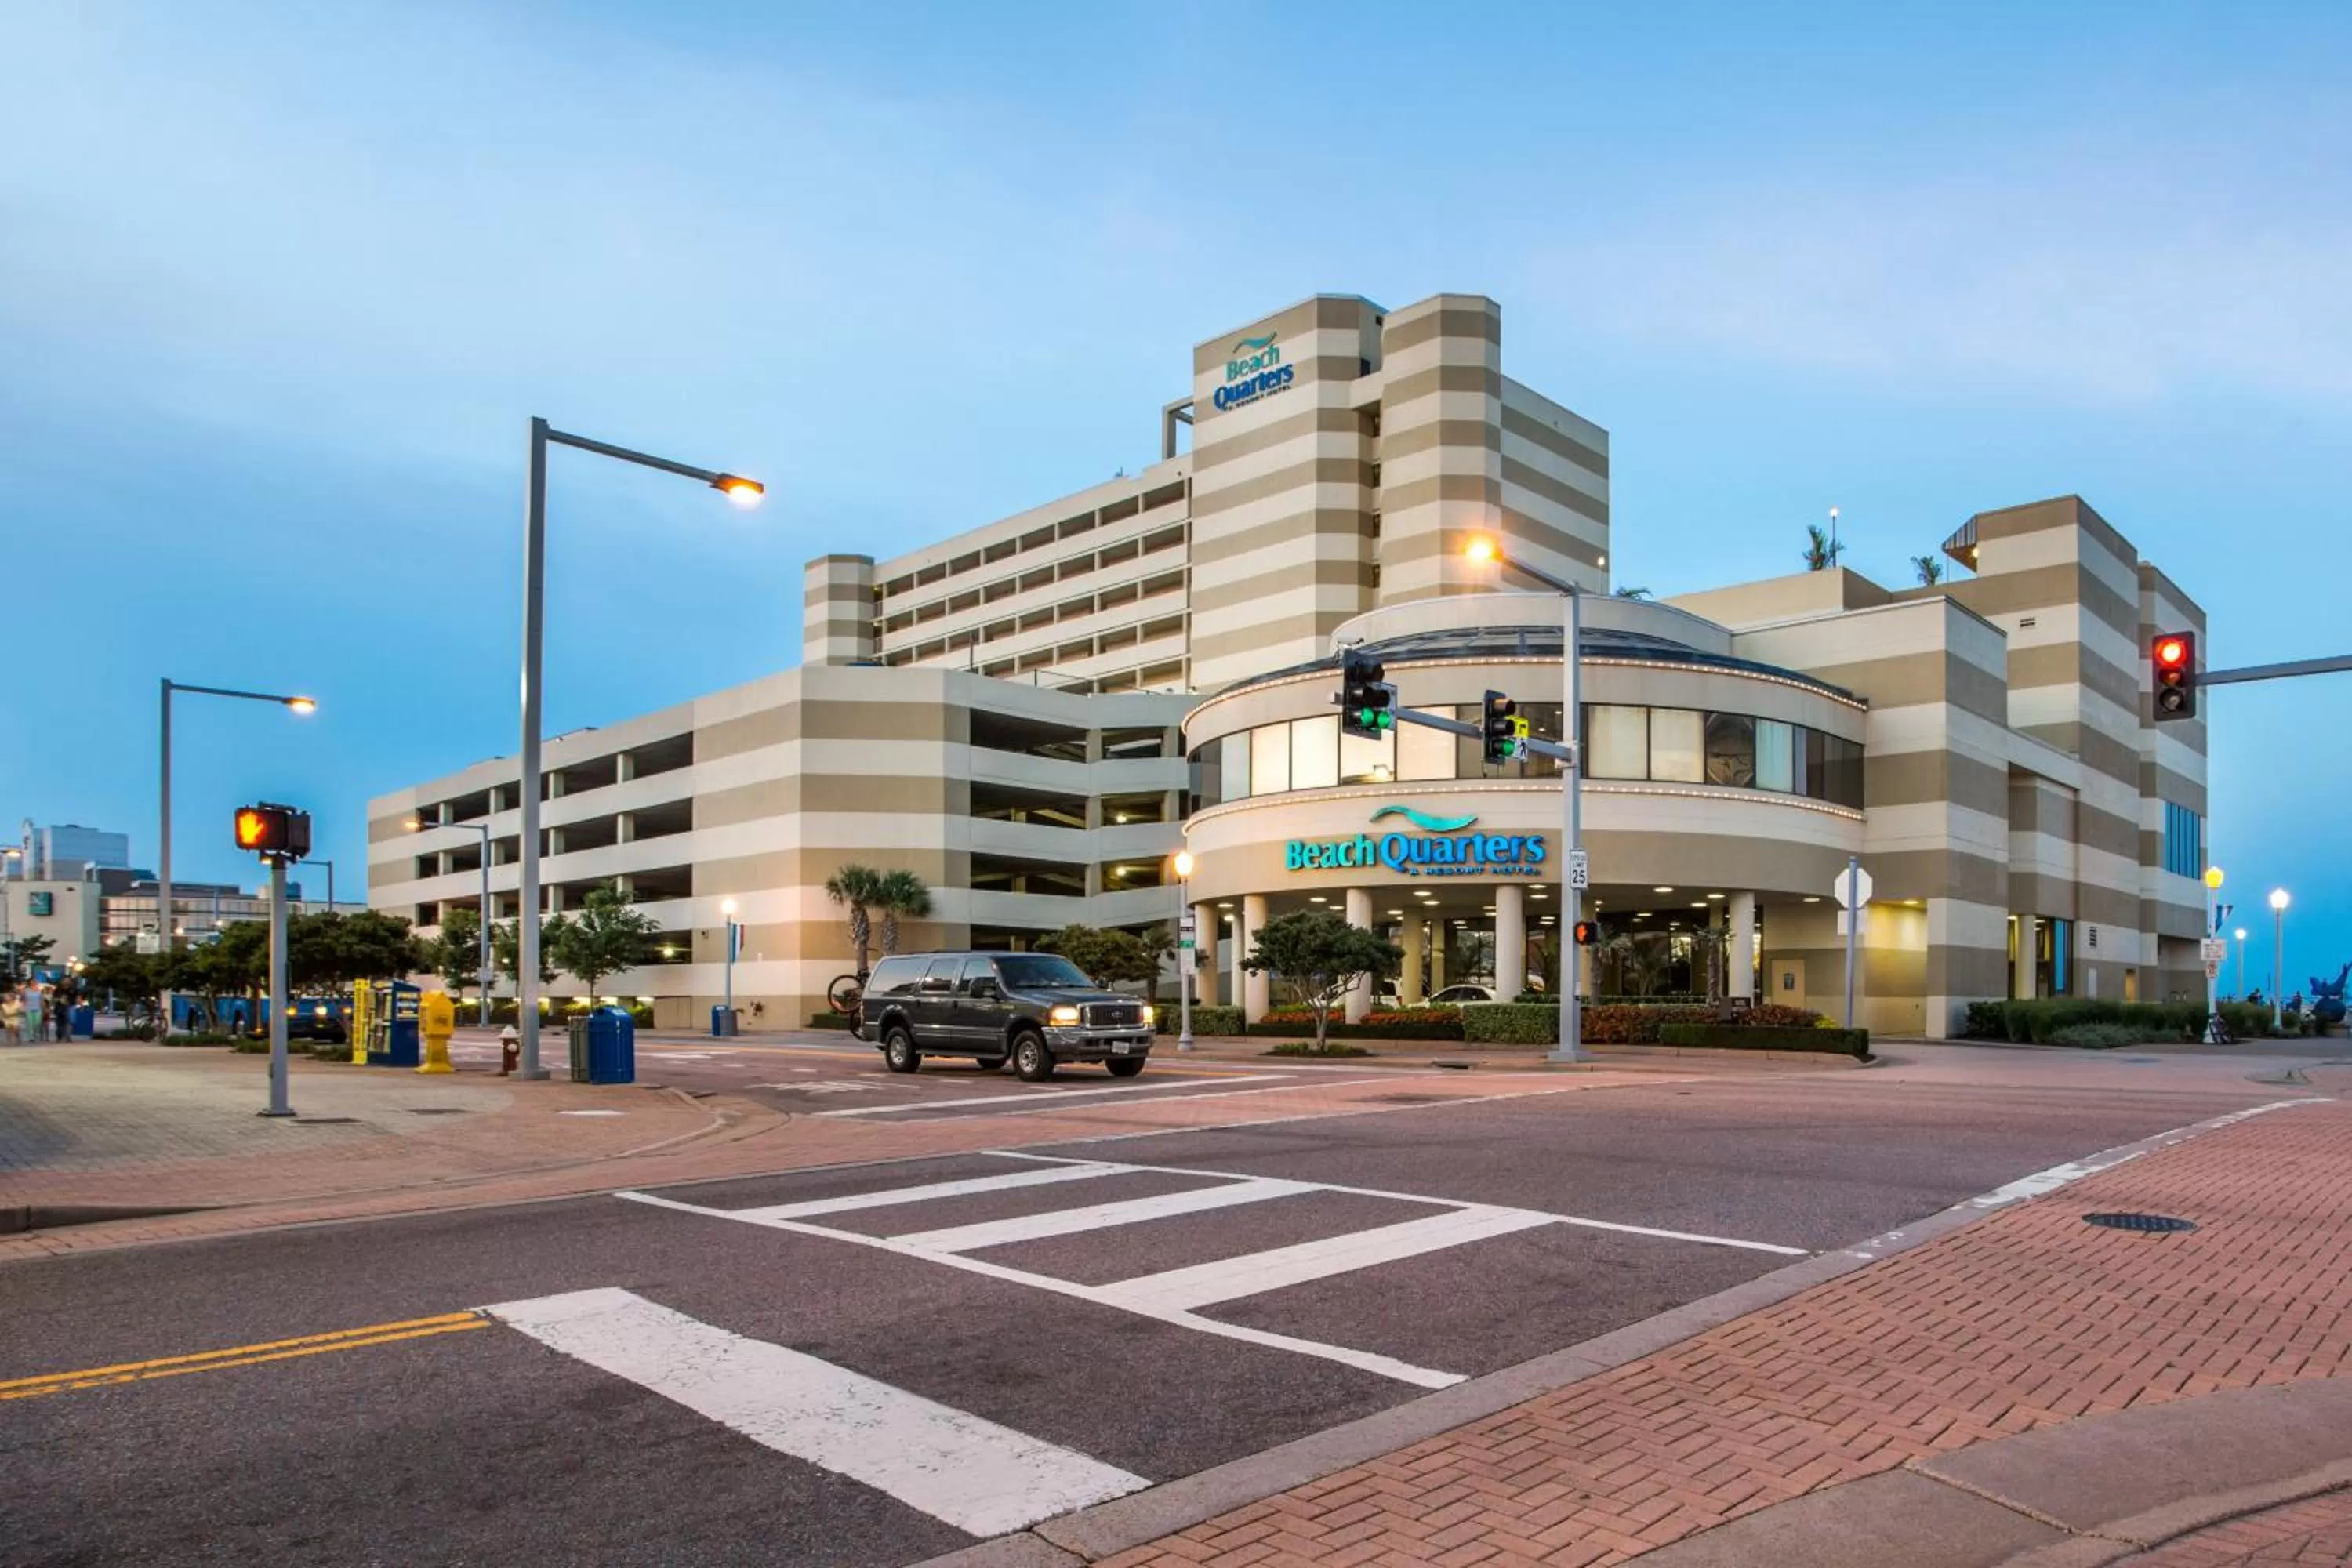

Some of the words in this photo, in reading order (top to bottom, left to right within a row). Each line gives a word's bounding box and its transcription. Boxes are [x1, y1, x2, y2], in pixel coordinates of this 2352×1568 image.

[1226, 345, 1281, 382] Beach
[1214, 363, 1295, 411] Quarters
[1285, 833, 1376, 871] Beach
[1378, 832, 1546, 873] Quarters
[1573, 869, 1586, 884] 25
